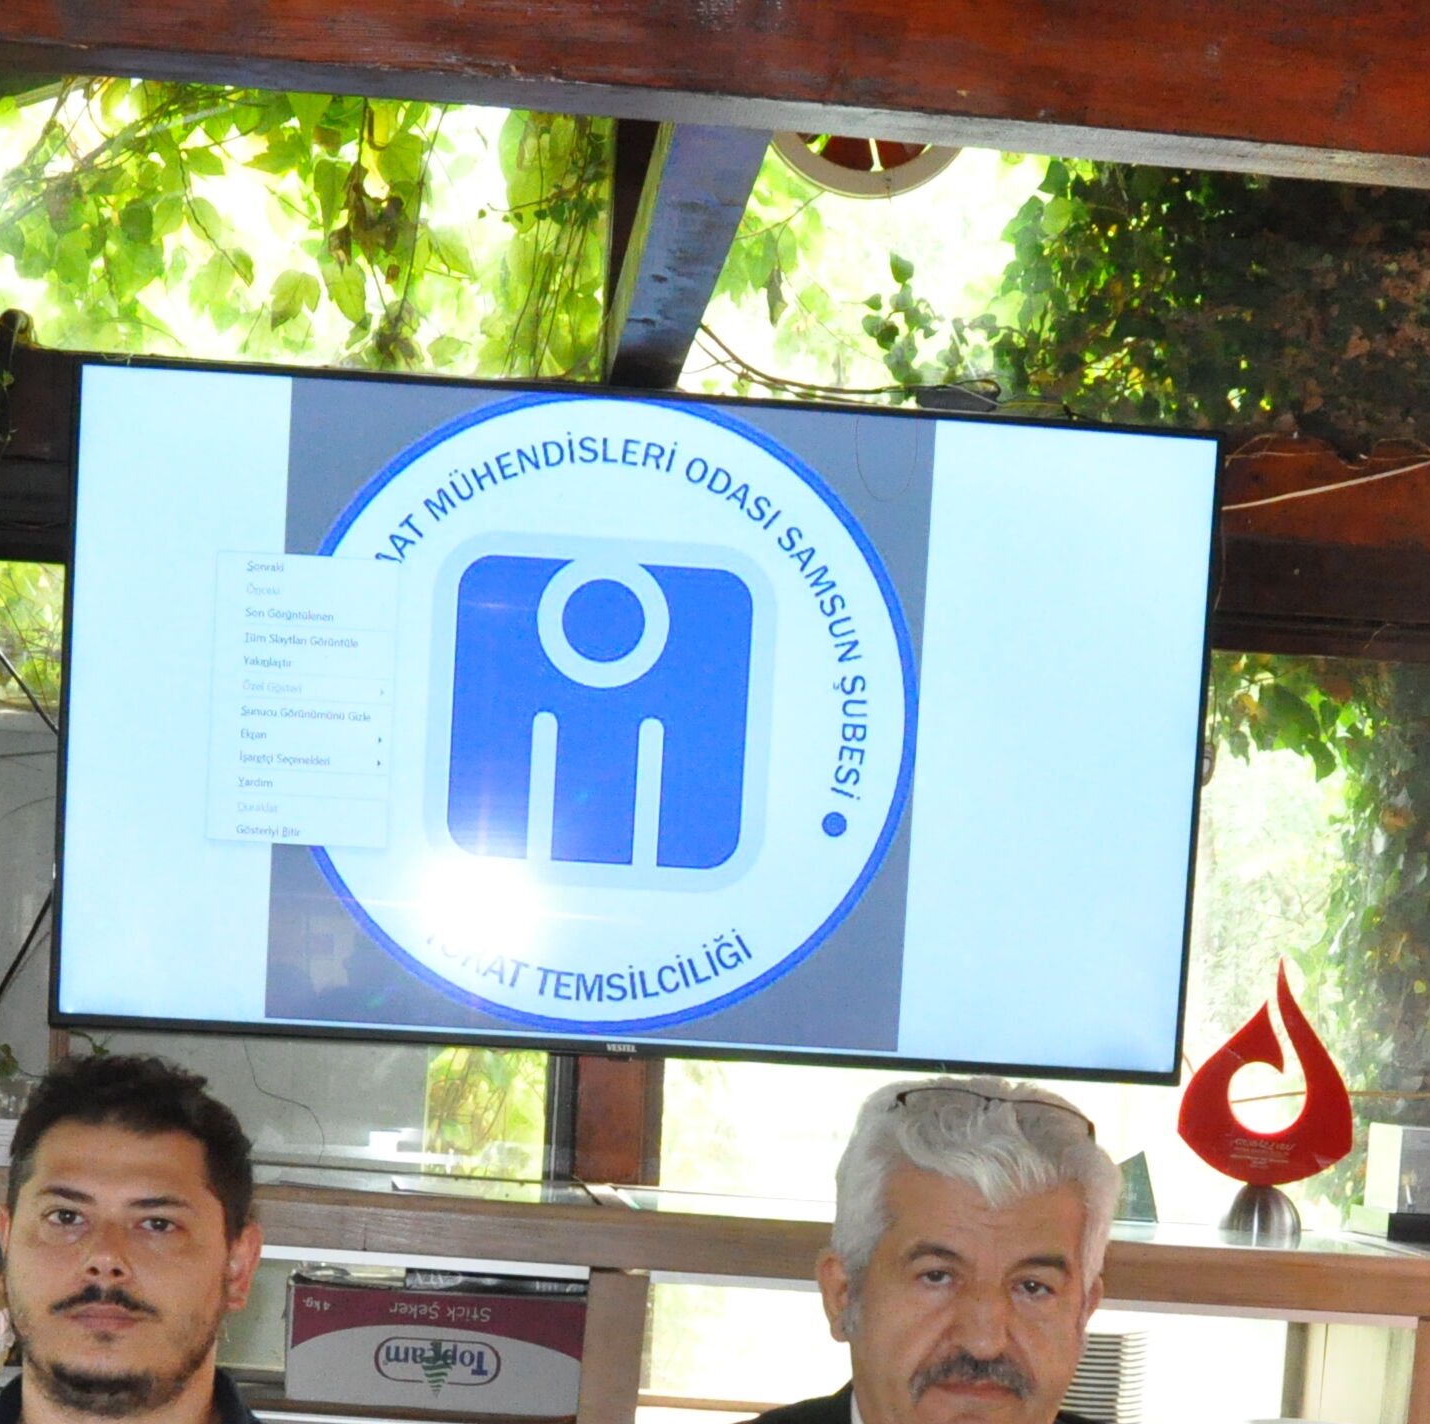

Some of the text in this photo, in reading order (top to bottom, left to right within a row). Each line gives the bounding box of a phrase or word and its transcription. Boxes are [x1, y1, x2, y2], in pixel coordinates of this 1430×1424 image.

[246, 560, 284, 572] Sonraki
[245, 607, 265, 618] Son
[423, 431, 678, 521] MÜHENDİSLERİ
[685, 457, 781, 530] ODASI
[777, 526, 863, 664] SAMSUN
[831, 675, 867, 801] ŞUBESİ
[536, 928, 753, 1002] TEMSİLCİLİĞİ
[389, 1299, 492, 1323] Stick Şeker
